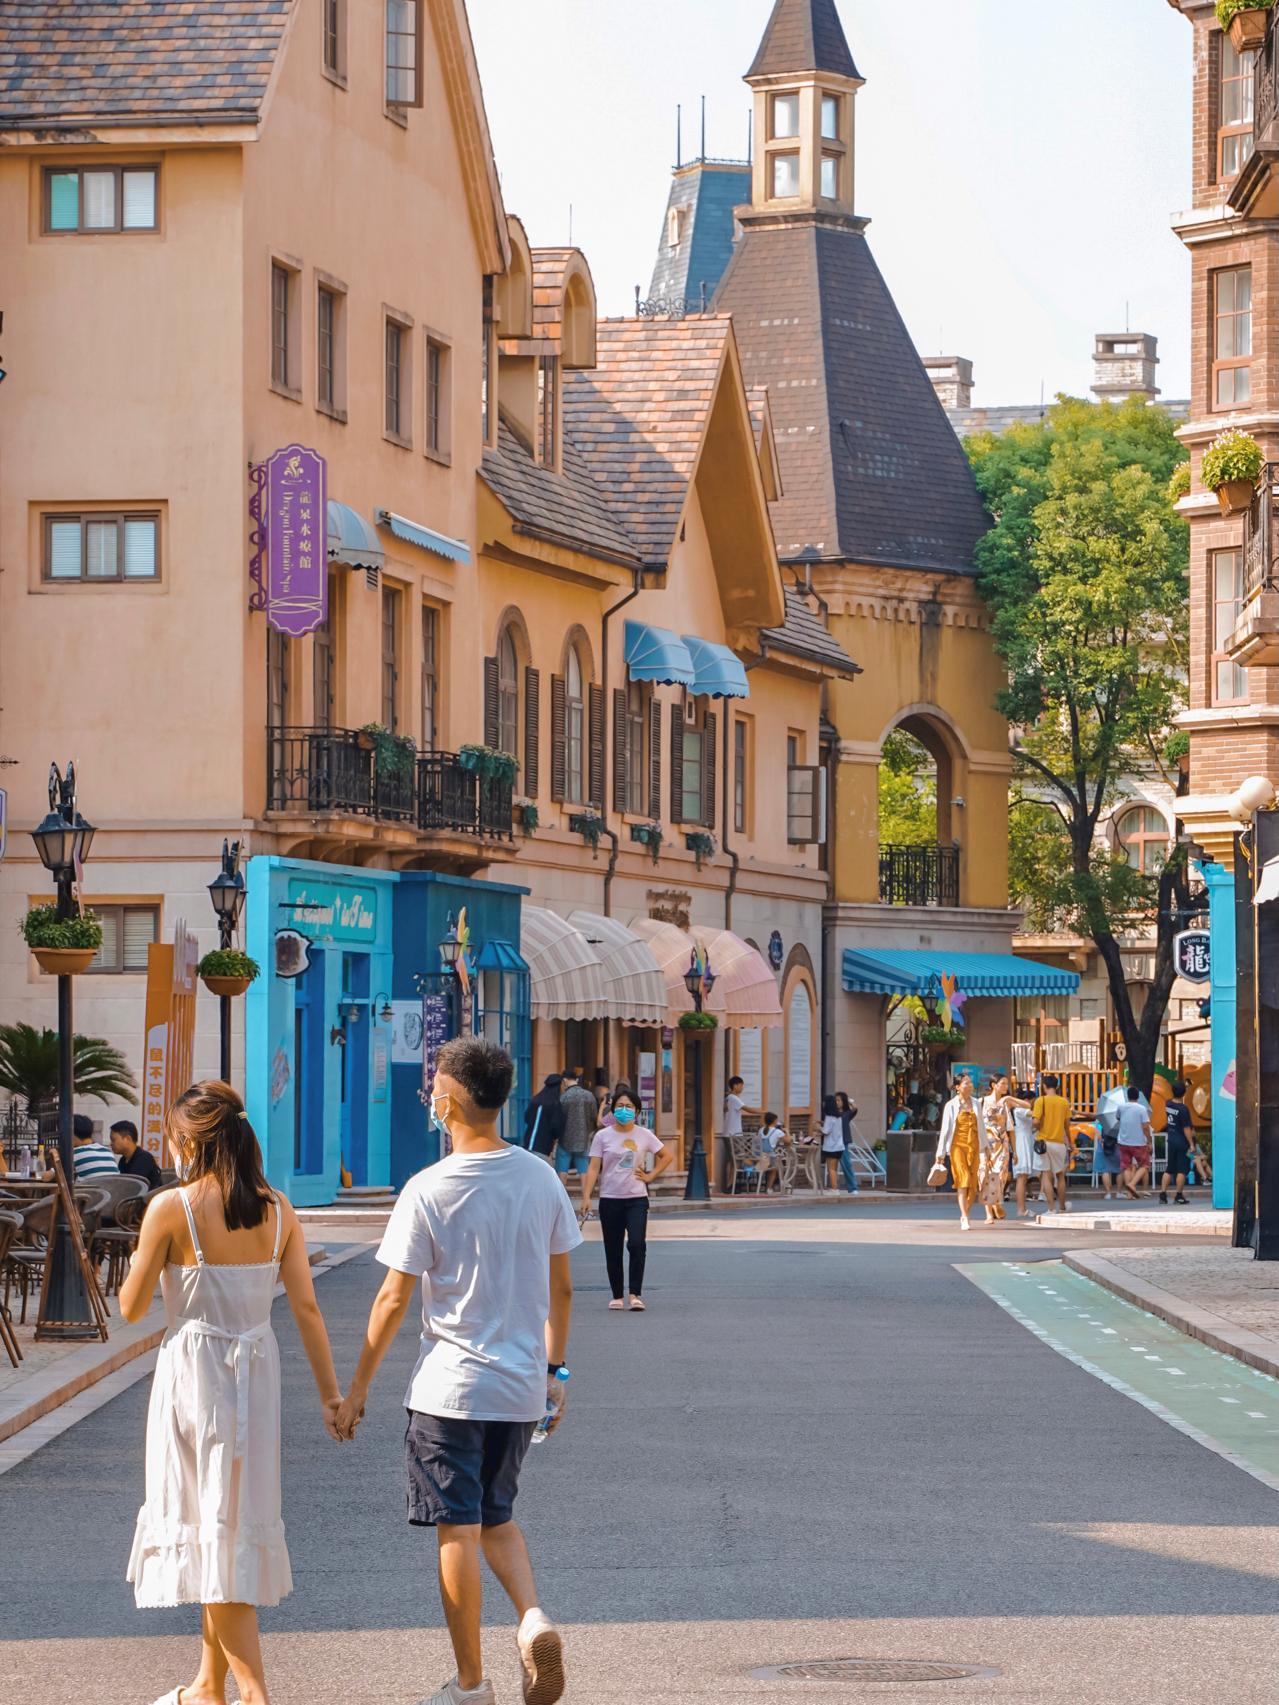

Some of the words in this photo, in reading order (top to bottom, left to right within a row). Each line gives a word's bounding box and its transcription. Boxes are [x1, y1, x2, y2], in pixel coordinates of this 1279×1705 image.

[279, 492, 294, 528] Dragon
[282, 529, 294, 573] Fountain
[279, 574, 293, 593] Spa
[1182, 937, 1200, 946] LONG
